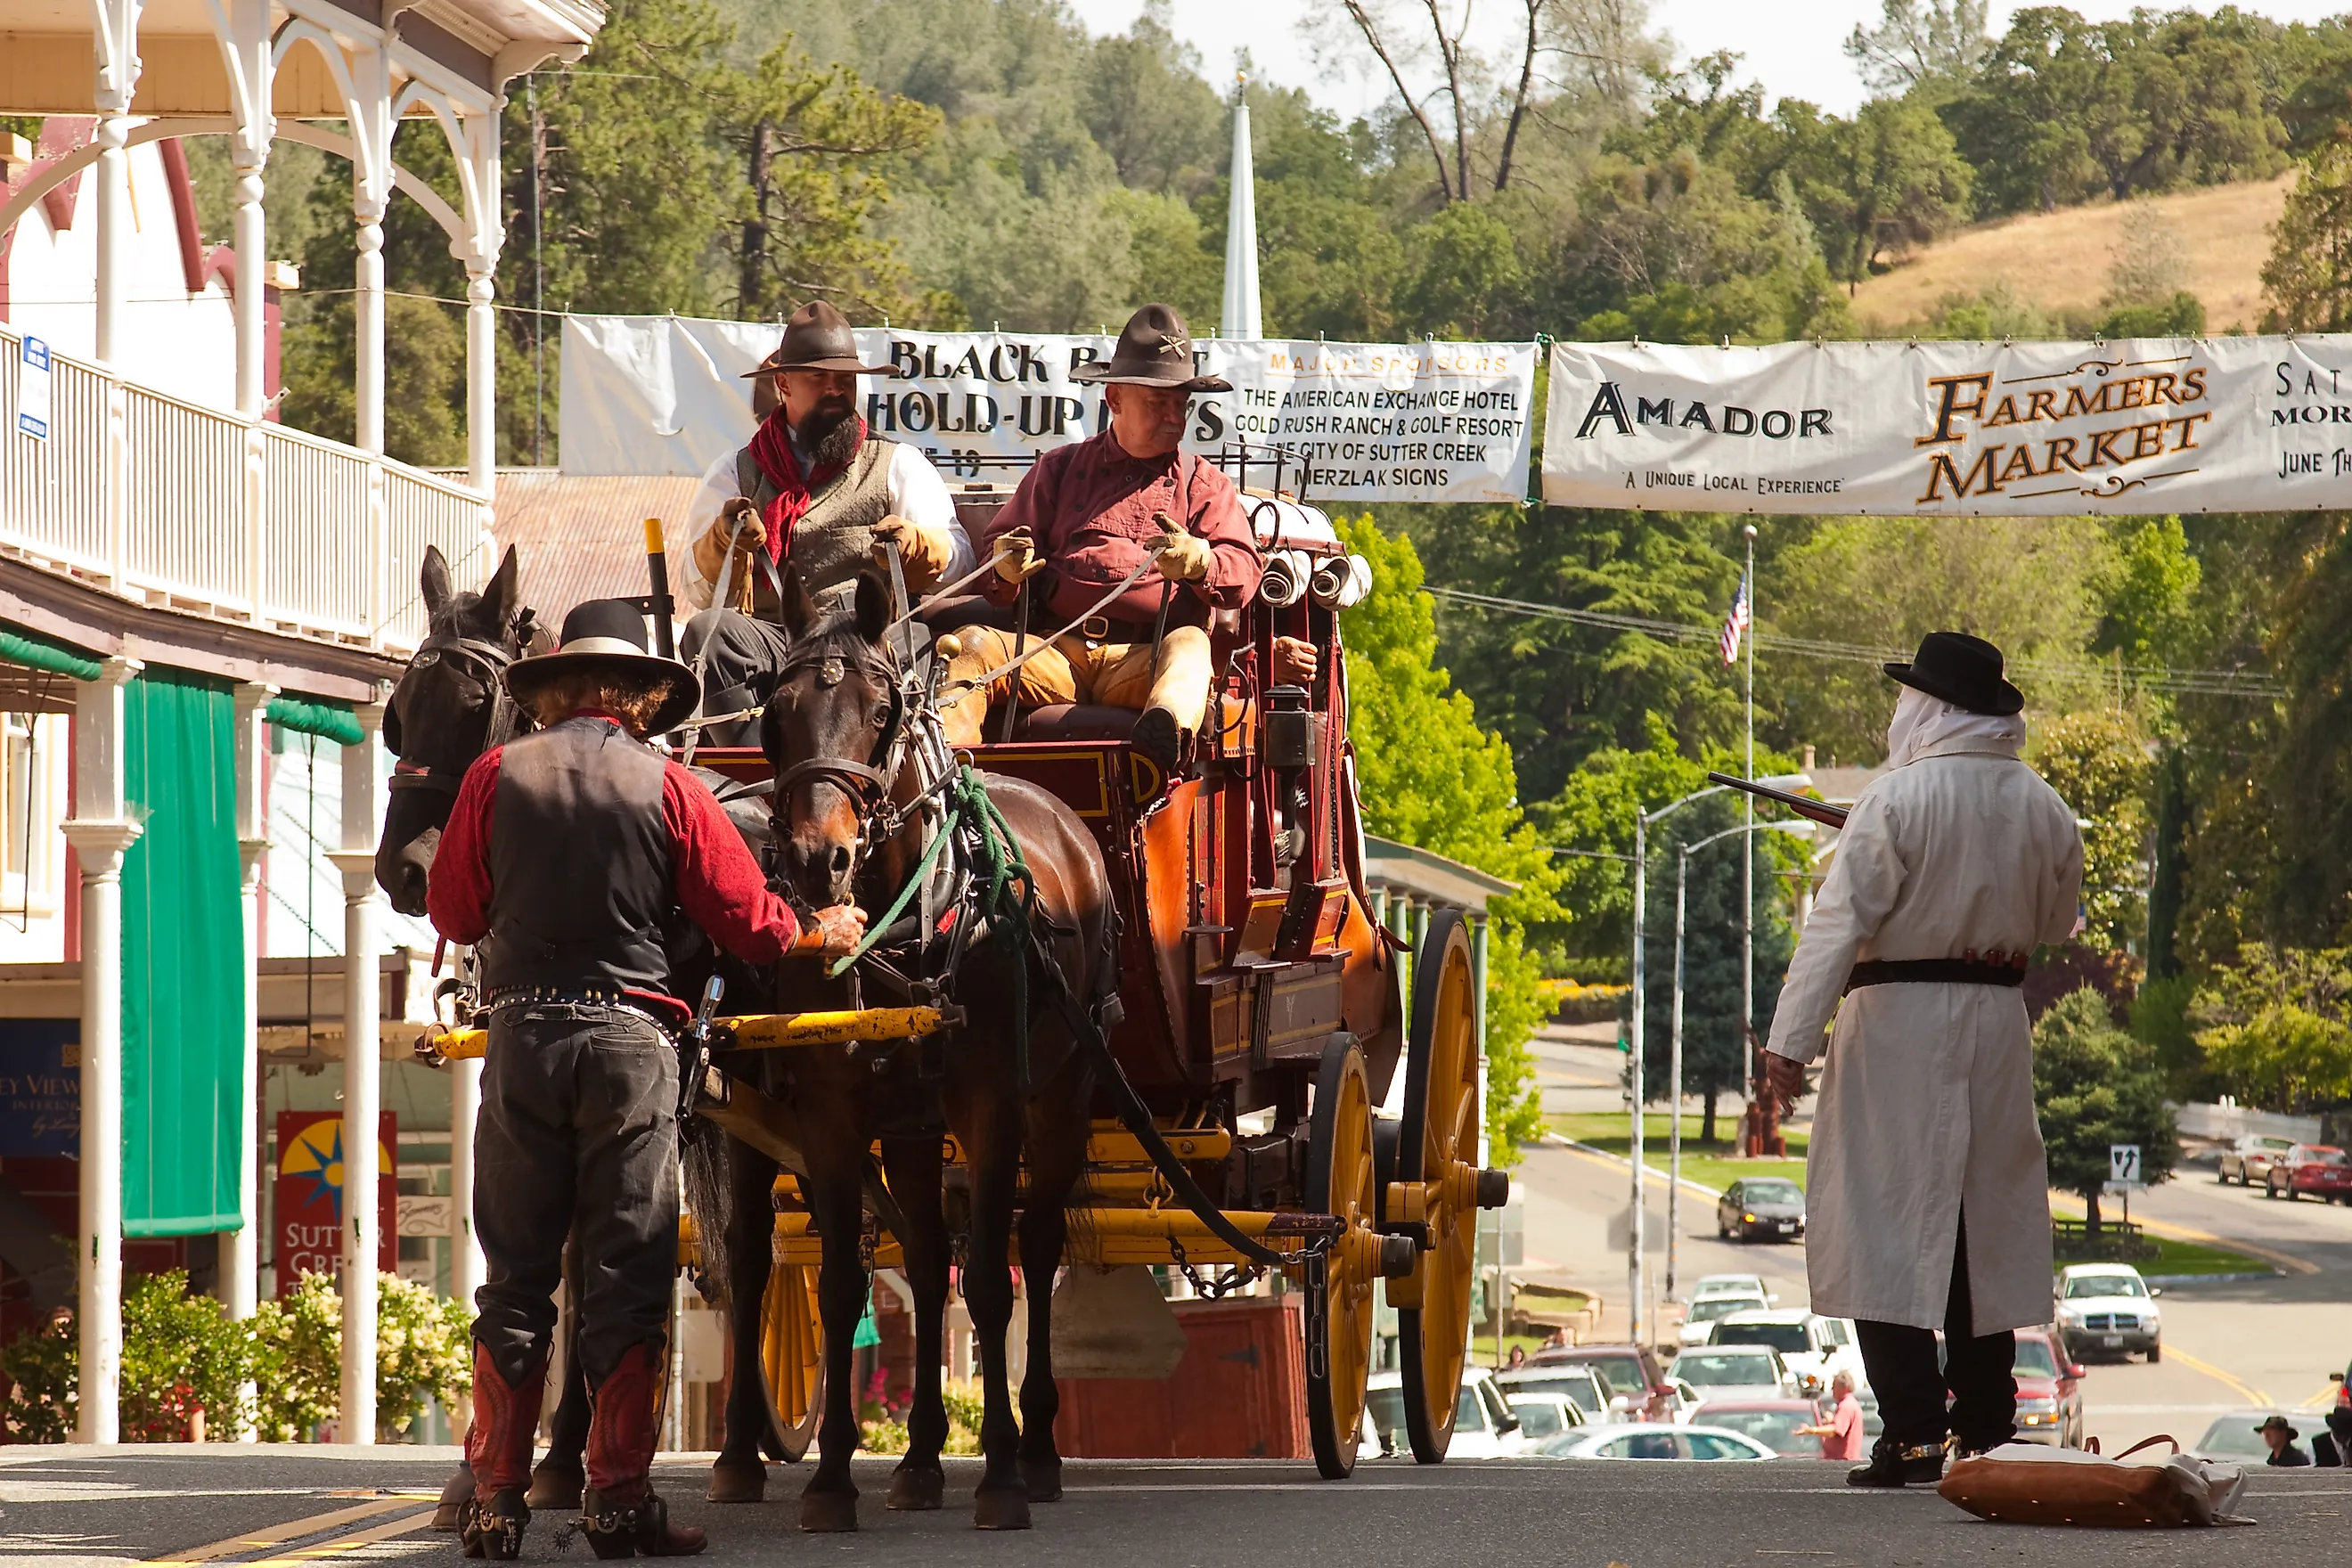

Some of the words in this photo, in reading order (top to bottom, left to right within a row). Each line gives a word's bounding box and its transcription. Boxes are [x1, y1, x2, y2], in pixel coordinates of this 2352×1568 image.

[889, 341, 1049, 383] BLACK
[1270, 354, 1356, 372] MAJOR
[1371, 356, 1507, 373] SPONSORS
[1245, 388, 1277, 407] THE
[1281, 390, 1369, 409] AMERICAN
[1374, 390, 1460, 410] EXCHANGE
[1464, 390, 1519, 411] HOTEL
[1574, 381, 1833, 440] AMADOR
[1914, 367, 2208, 449] FARMERS
[867, 390, 1085, 437] HOLD-UP
[1235, 414, 1280, 434] GOLD
[1284, 415, 1327, 434] RUSH
[1331, 416, 1392, 435] RANCH
[1396, 418, 1407, 437] &
[1410, 416, 1451, 434] GOLF
[1456, 417, 1523, 437] RESORT
[1300, 442, 1338, 460] CITY
[1343, 442, 1365, 461] OF
[1369, 443, 1427, 462] SUTTER
[1433, 443, 1487, 462] CREEK
[1915, 411, 2212, 506] MARKET
[1294, 469, 1387, 486] MERZLAK
[1392, 468, 1449, 486] SIGNS
[2278, 451, 2323, 479] JUNE
[1646, 470, 1695, 488] UNIQUE
[1703, 473, 1749, 491] LOCAL
